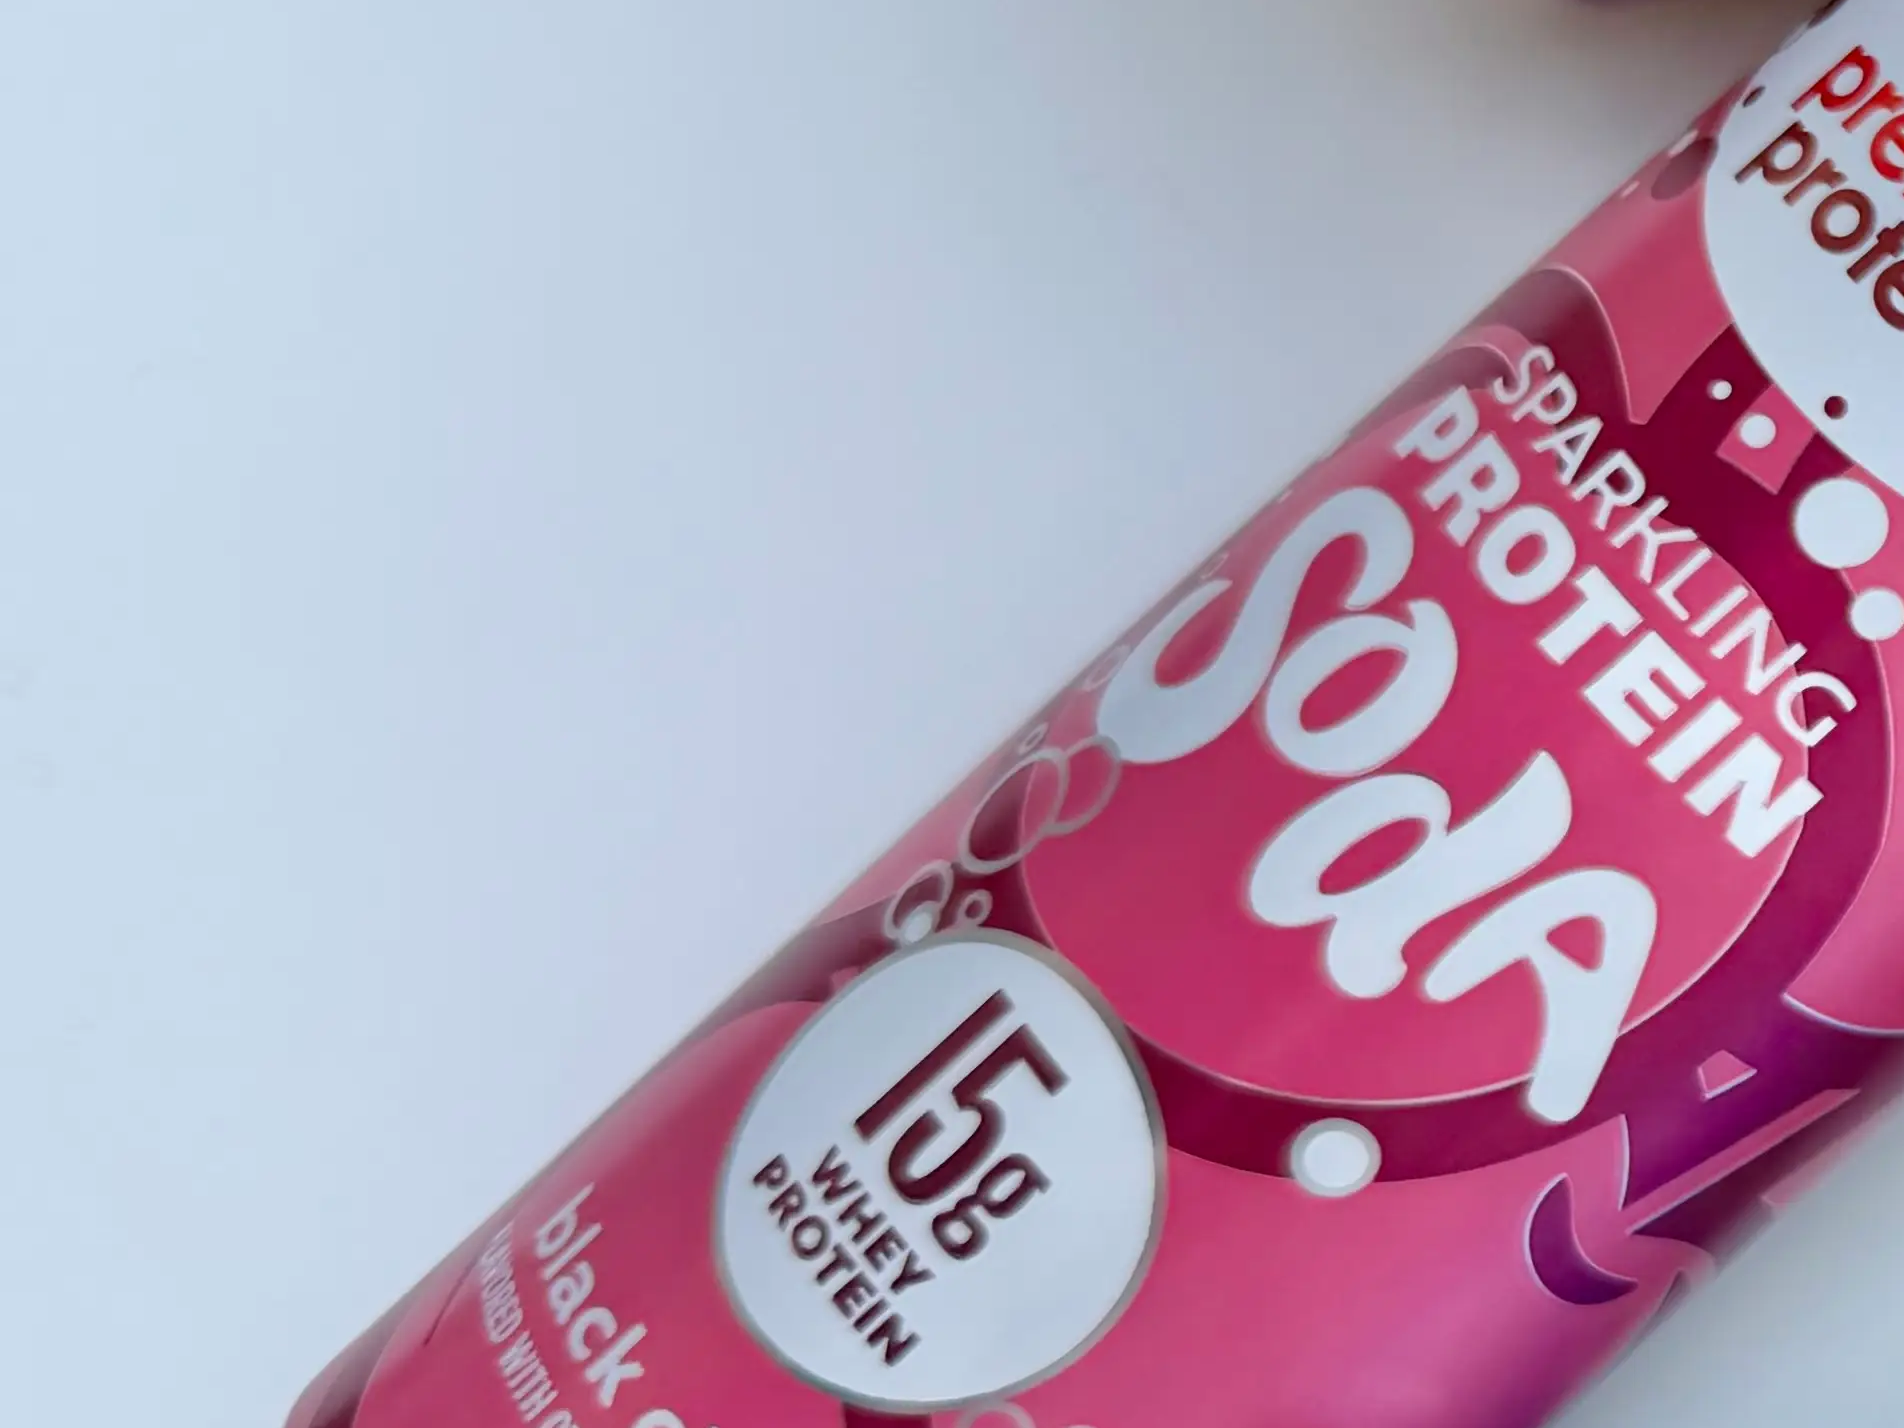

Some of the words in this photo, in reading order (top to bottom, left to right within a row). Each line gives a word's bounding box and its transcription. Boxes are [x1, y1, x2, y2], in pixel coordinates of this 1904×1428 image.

[1395, 386, 1825, 858] PROTEIN
[1494, 345, 1857, 747] SPARKLING
[810, 1145, 936, 1294] WHEY
[854, 988, 1070, 1262] 15g
[534, 1181, 648, 1408] black
[753, 1154, 922, 1367] PROTEIN
[499, 1329, 560, 1424] WITH
